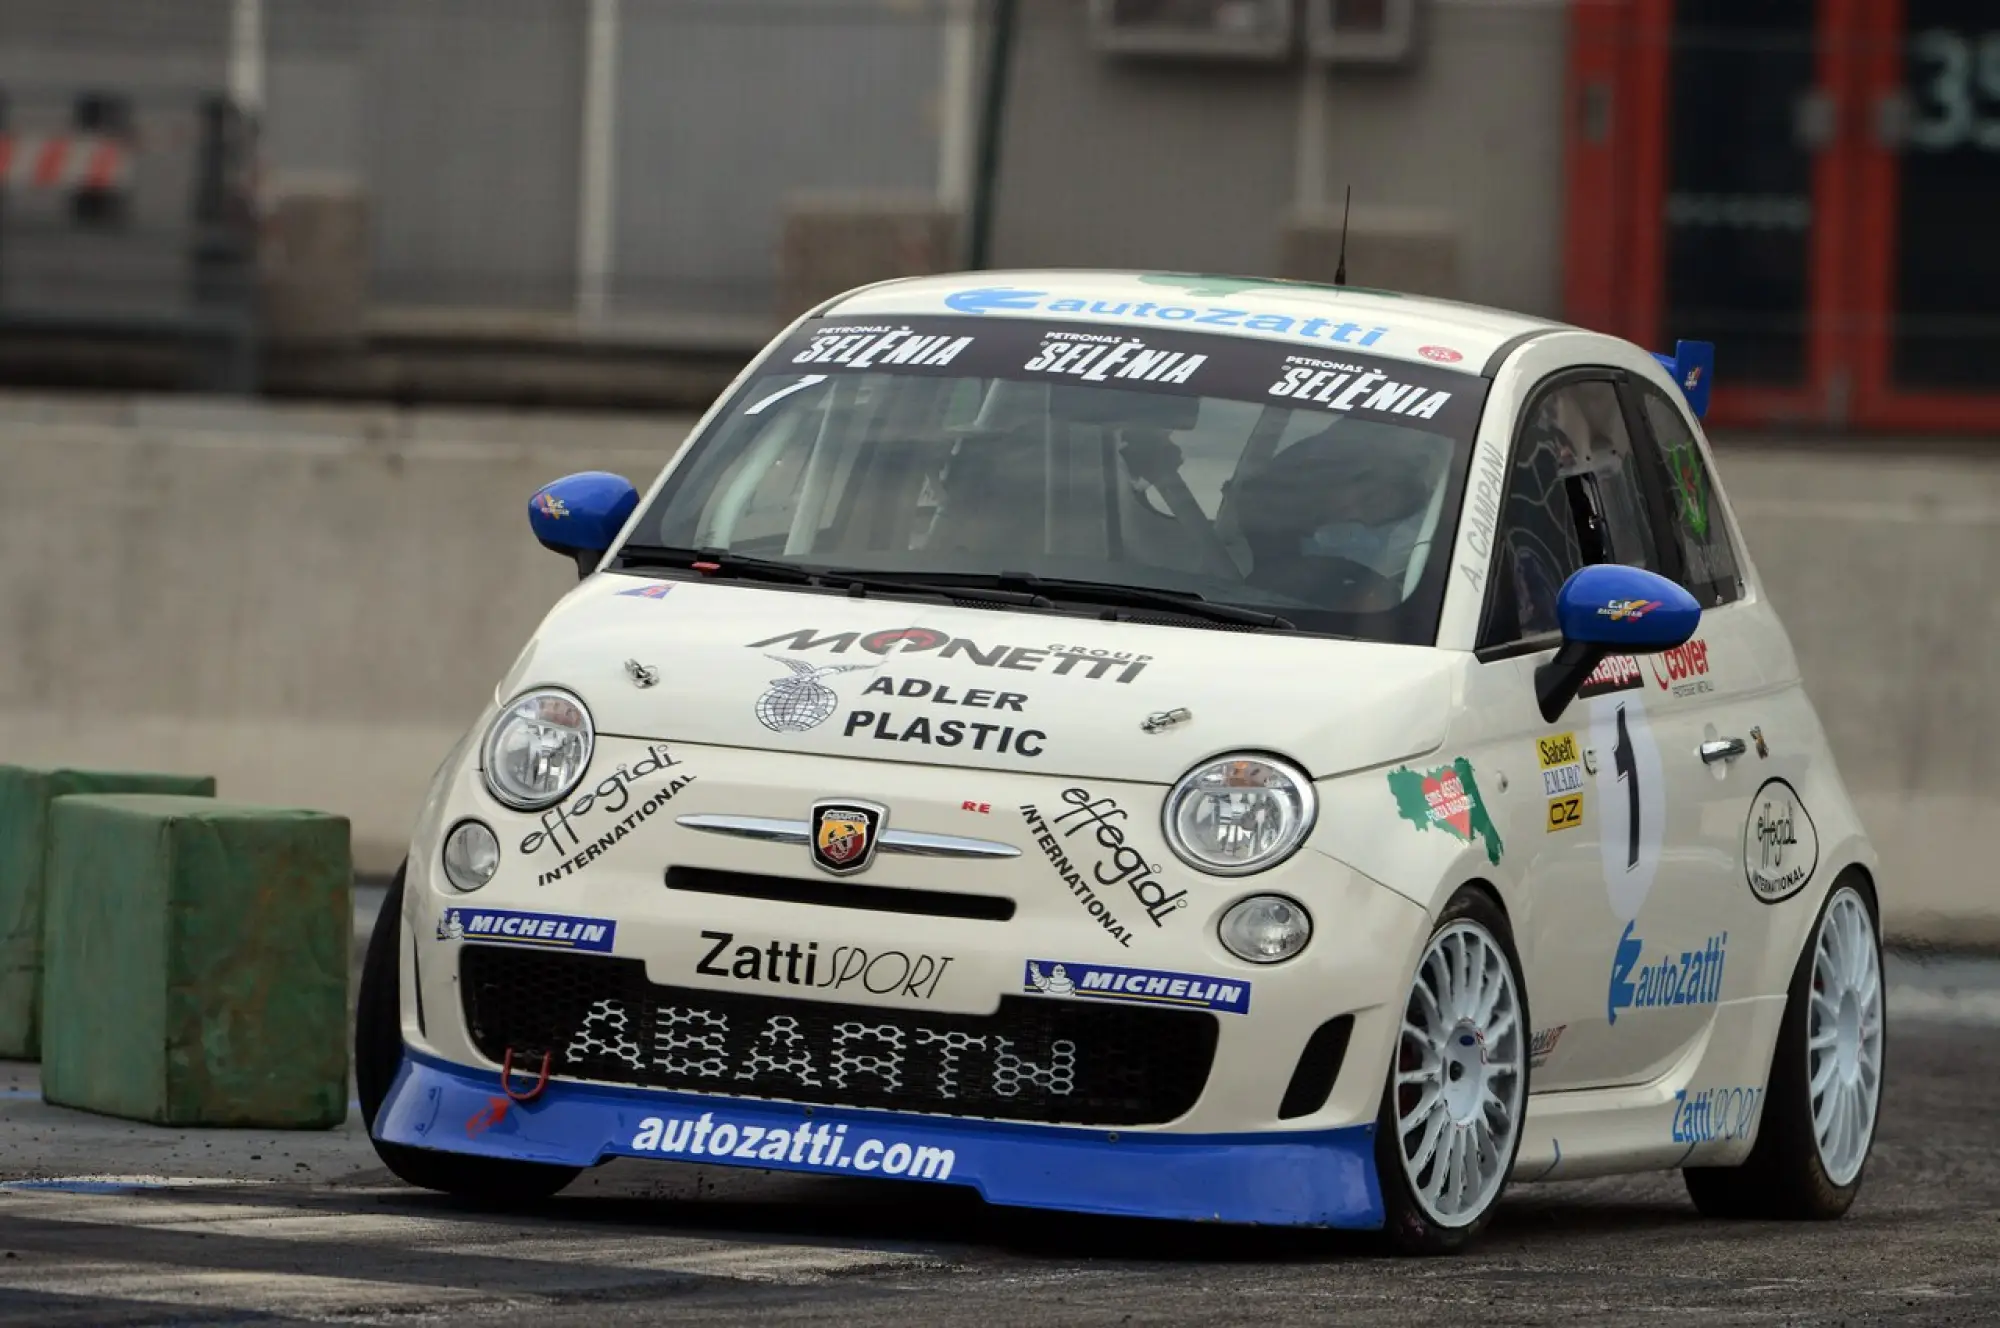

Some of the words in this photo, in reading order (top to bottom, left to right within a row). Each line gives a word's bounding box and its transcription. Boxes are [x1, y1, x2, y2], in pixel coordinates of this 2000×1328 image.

[816, 325, 892, 335] PETRONAS
[1045, 331, 1122, 345] PETRONAS
[1047, 297, 1391, 347] autozatti
[1285, 355, 1364, 373] PETRONAS
[1466, 440, 1506, 560] CAMPANI
[744, 627, 1153, 684] MONETTI
[1047, 642, 1154, 662] GROUP
[1662, 637, 1710, 681] cover
[861, 676, 1029, 712] ADLER
[843, 710, 1047, 757] PLASTIC
[1540, 736, 1576, 766] Sabelt
[519, 744, 683, 857] effegidi
[1612, 701, 1640, 874] 1
[537, 774, 698, 887] INTERNATIONAL
[1019, 803, 1134, 949] INTERNATIONAL
[1052, 788, 1189, 928] effegidi
[468, 904, 607, 943] MICHELIN
[1081, 970, 1243, 1004] MICHELIN
[566, 999, 1076, 1099] ABARTH
[631, 1111, 956, 1181] autozatti.com
